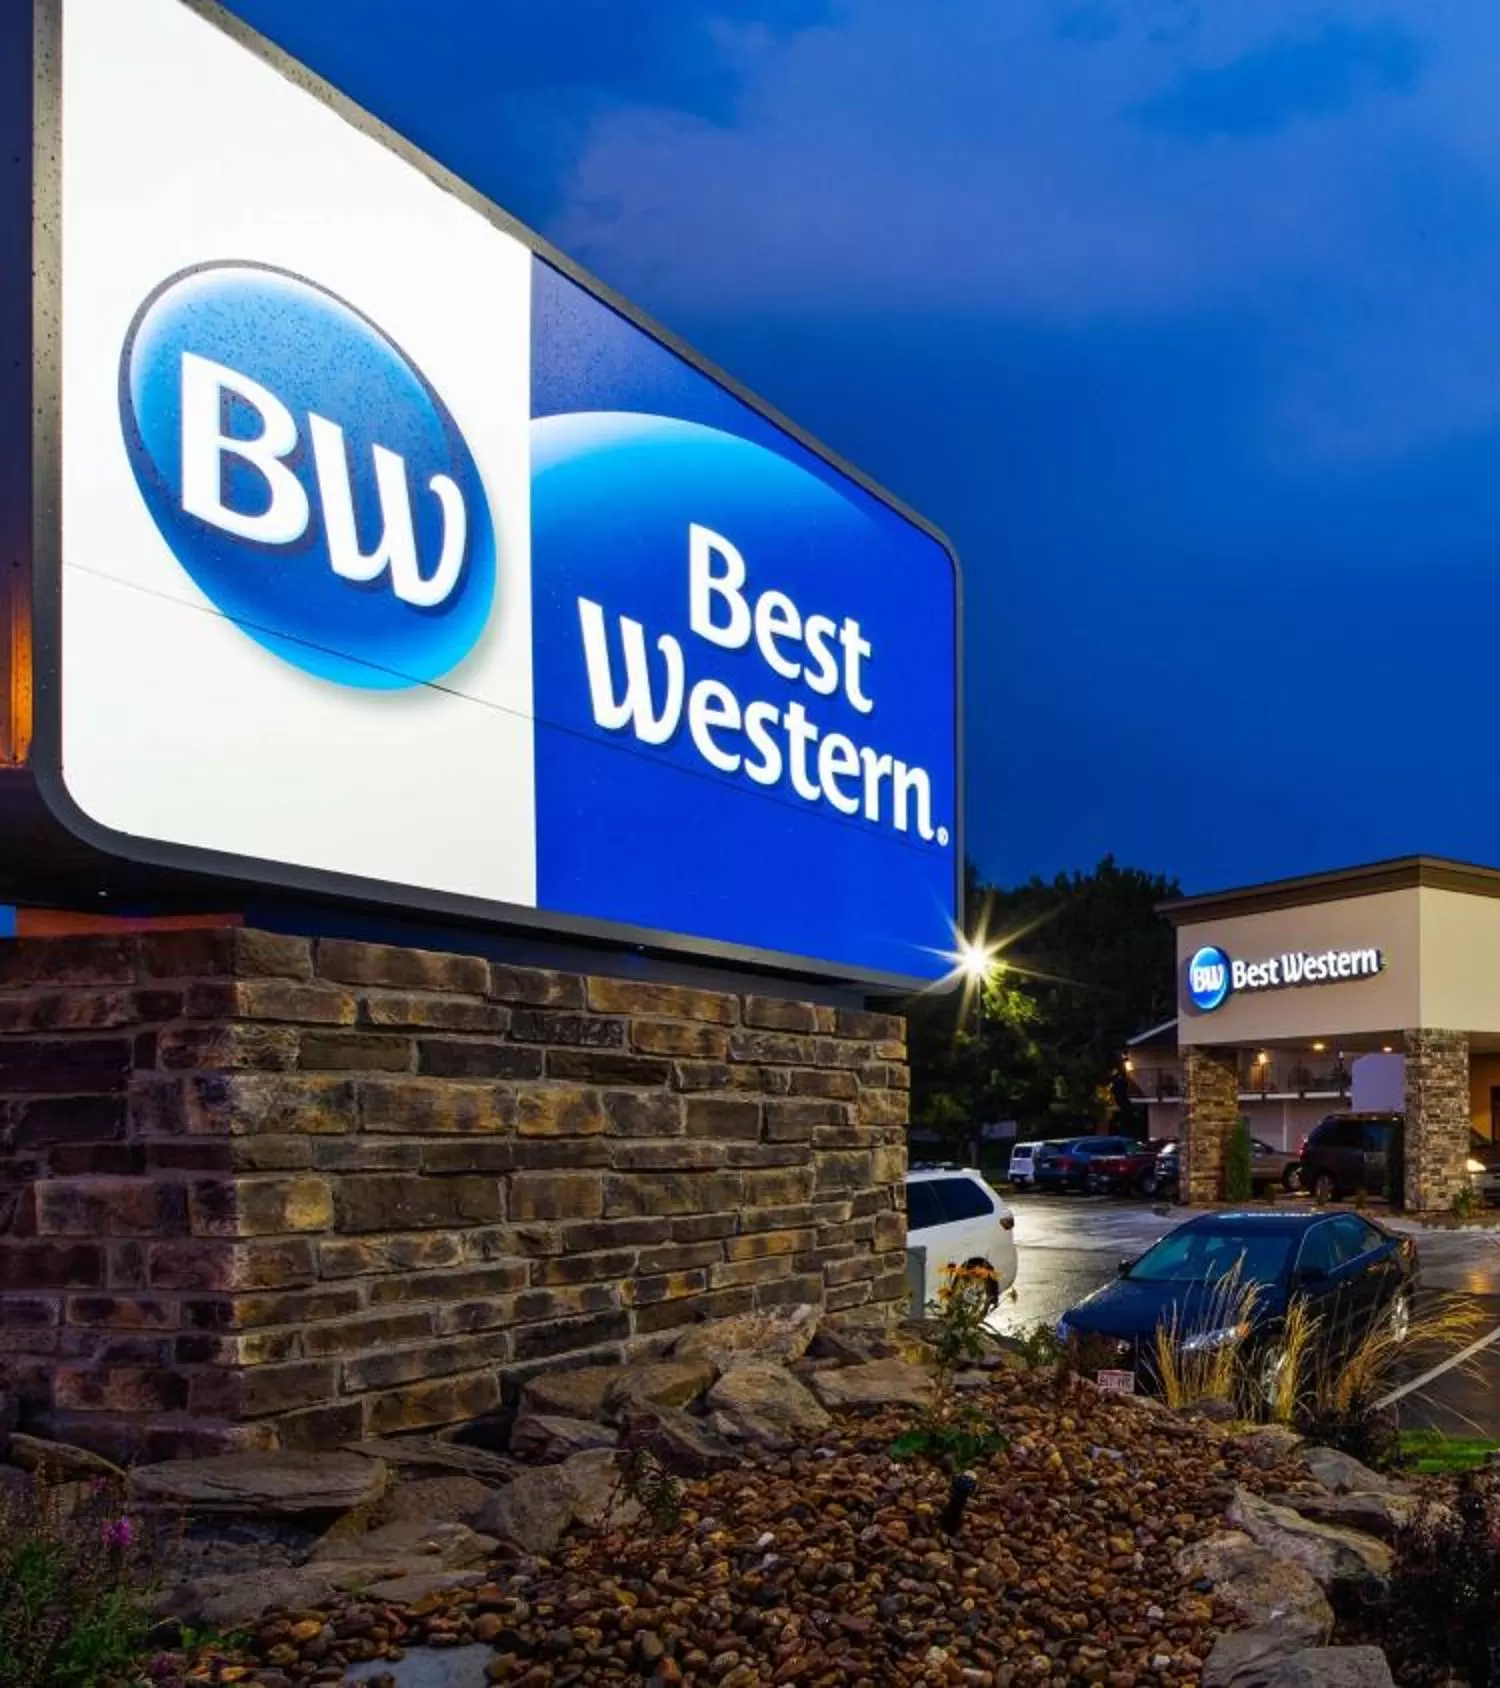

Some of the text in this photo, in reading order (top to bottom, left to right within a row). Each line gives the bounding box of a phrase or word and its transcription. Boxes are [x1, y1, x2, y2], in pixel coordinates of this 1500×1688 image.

[181, 351, 467, 608] BW
[689, 521, 873, 714] Best
[1193, 963, 1225, 993] BW
[1232, 948, 1378, 989] Best Western
